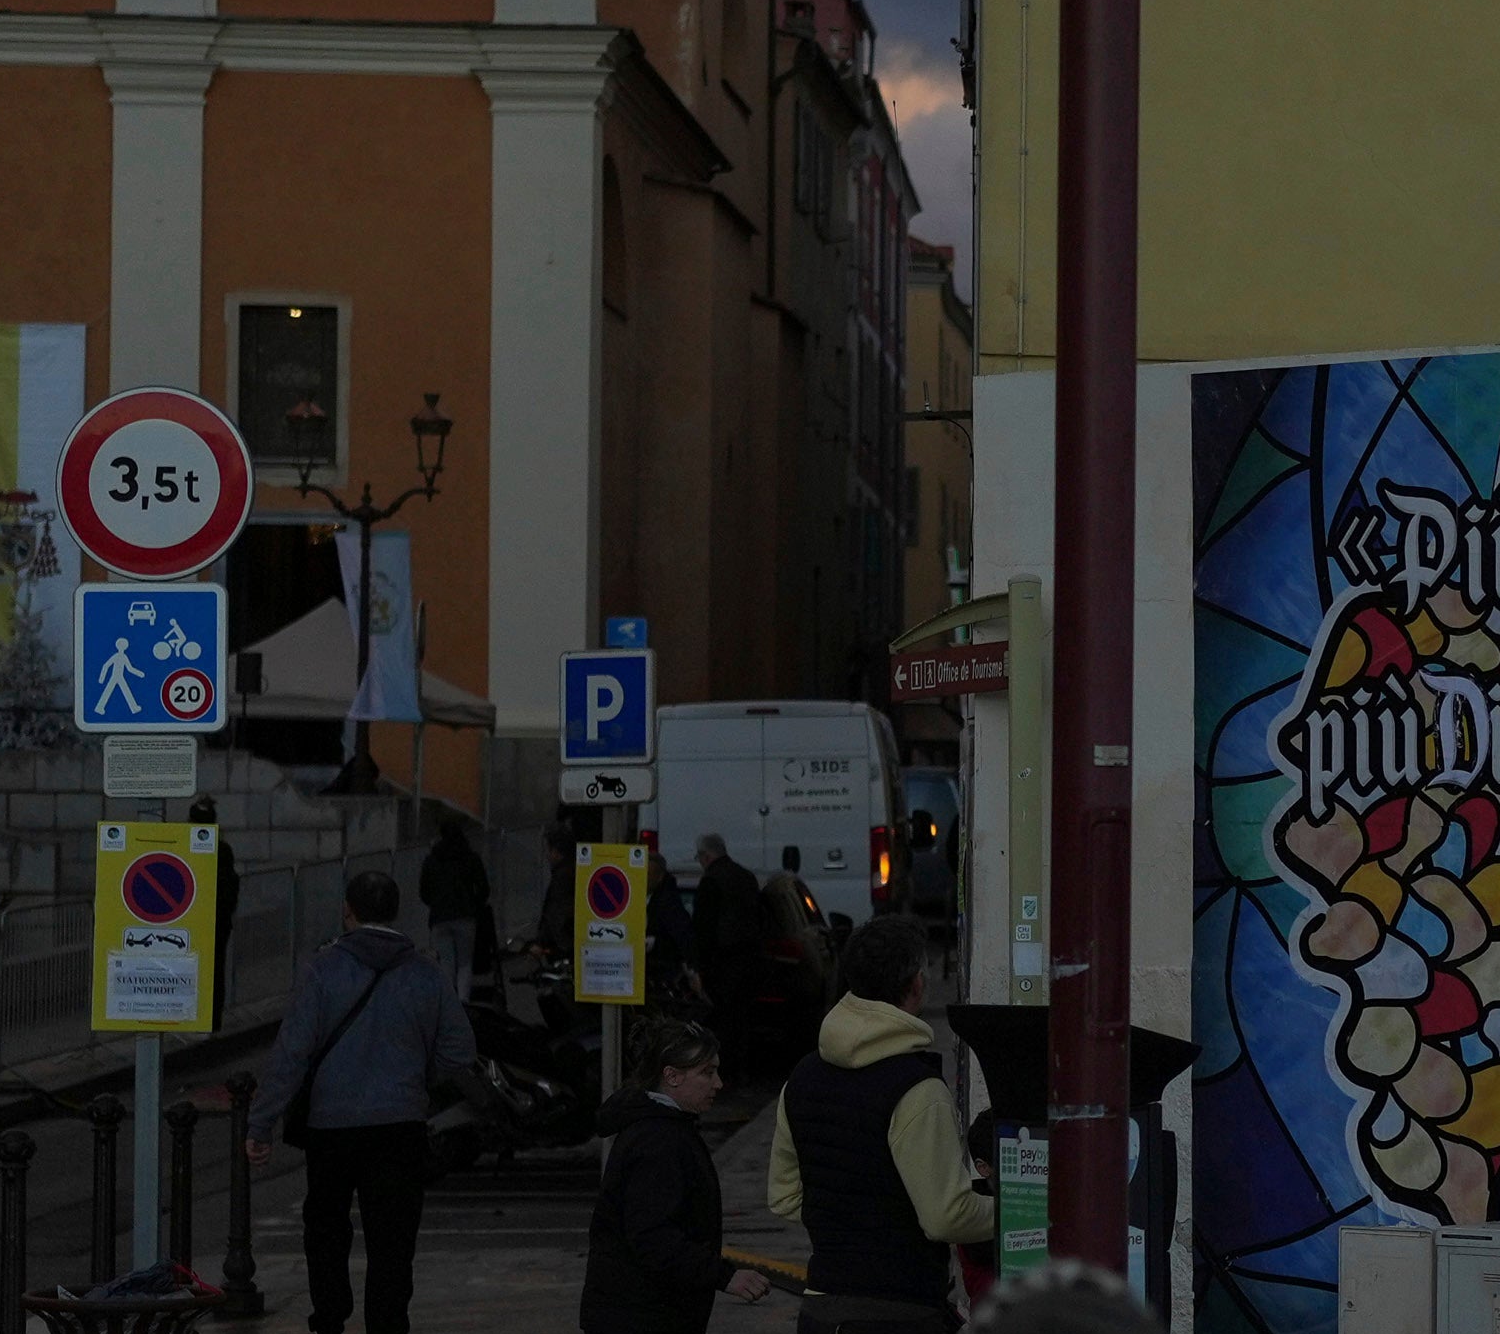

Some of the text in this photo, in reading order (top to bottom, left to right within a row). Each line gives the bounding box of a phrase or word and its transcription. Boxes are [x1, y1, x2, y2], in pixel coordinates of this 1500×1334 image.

[108, 456, 200, 509] 3,5t
[937, 656, 1003, 683] Office de Tourisme
[174, 686, 201, 703] 20
[586, 674, 625, 741] P
[1305, 672, 1426, 818] più
[116, 976, 192, 986] STATIONNEMENT
[132, 985, 176, 995] INTERDIT
[1020, 1163, 1049, 1177] phone
